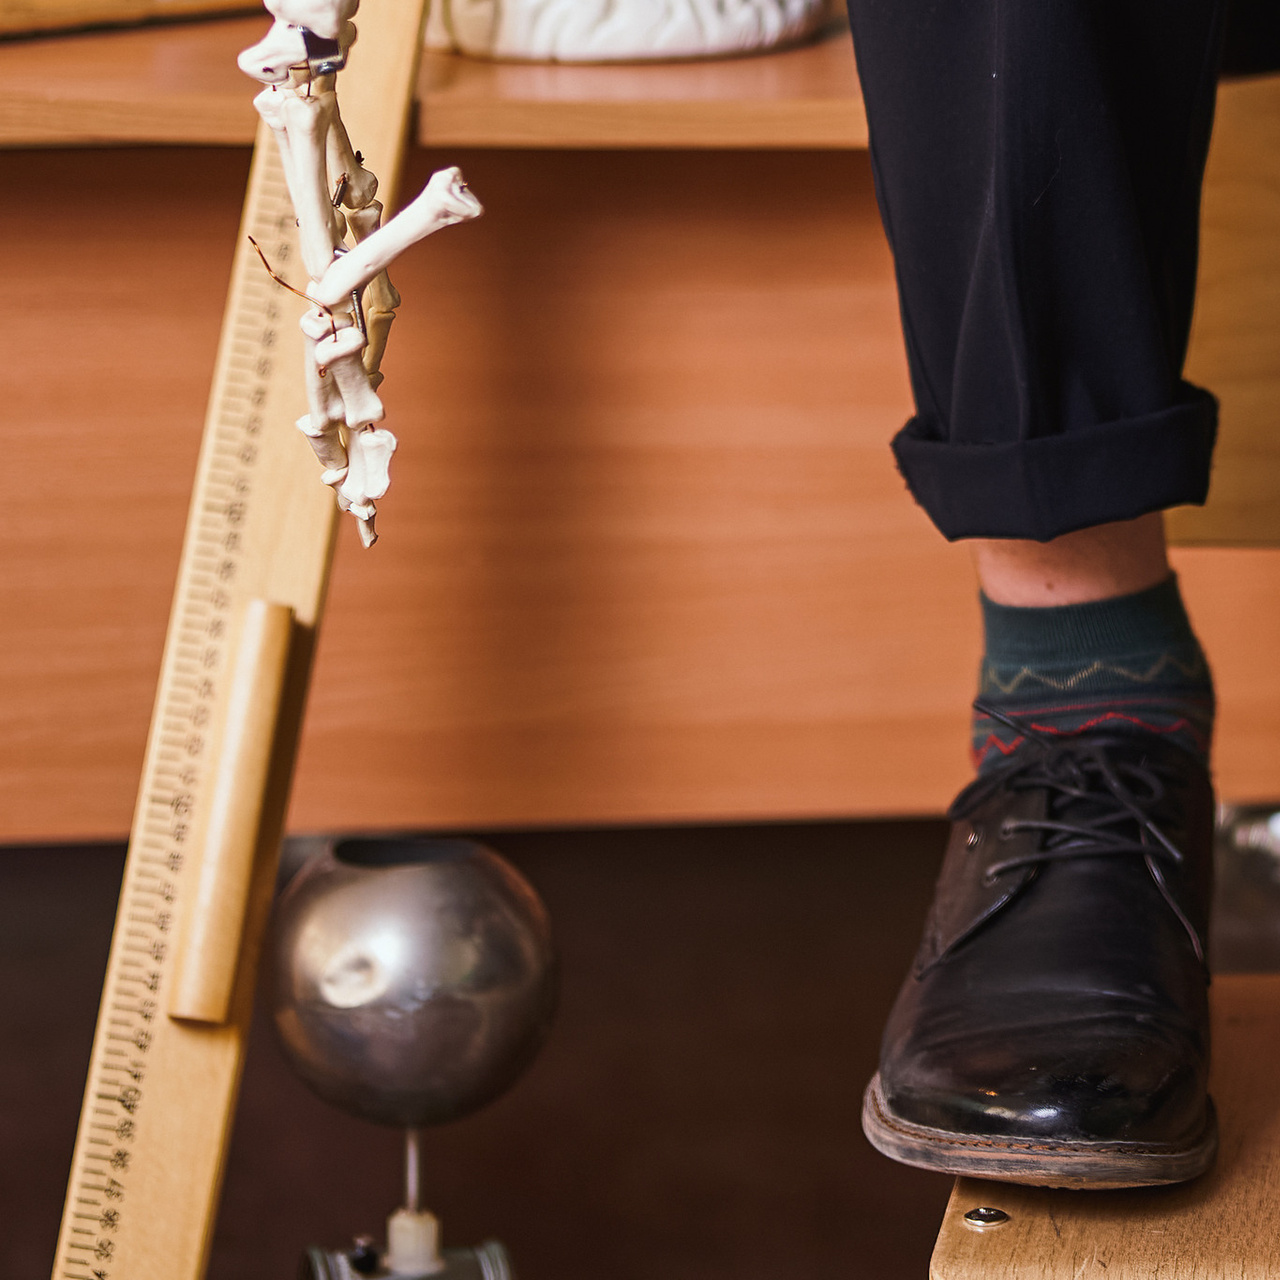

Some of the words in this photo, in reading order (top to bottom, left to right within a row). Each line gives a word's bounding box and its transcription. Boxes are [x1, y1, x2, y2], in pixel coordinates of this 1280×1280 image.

[146, 971, 161, 994] 44
[141, 999, 157, 1024] 43
[134, 1029, 151, 1052] 42
[127, 1060, 146, 1083] 41
[118, 1085, 142, 1115] 40
[115, 1118, 135, 1142] 39
[110, 1148, 131, 1173] 38
[104, 1178, 124, 1203] 37
[100, 1207, 120, 1233] 36
[94, 1237, 115, 1263] 35
